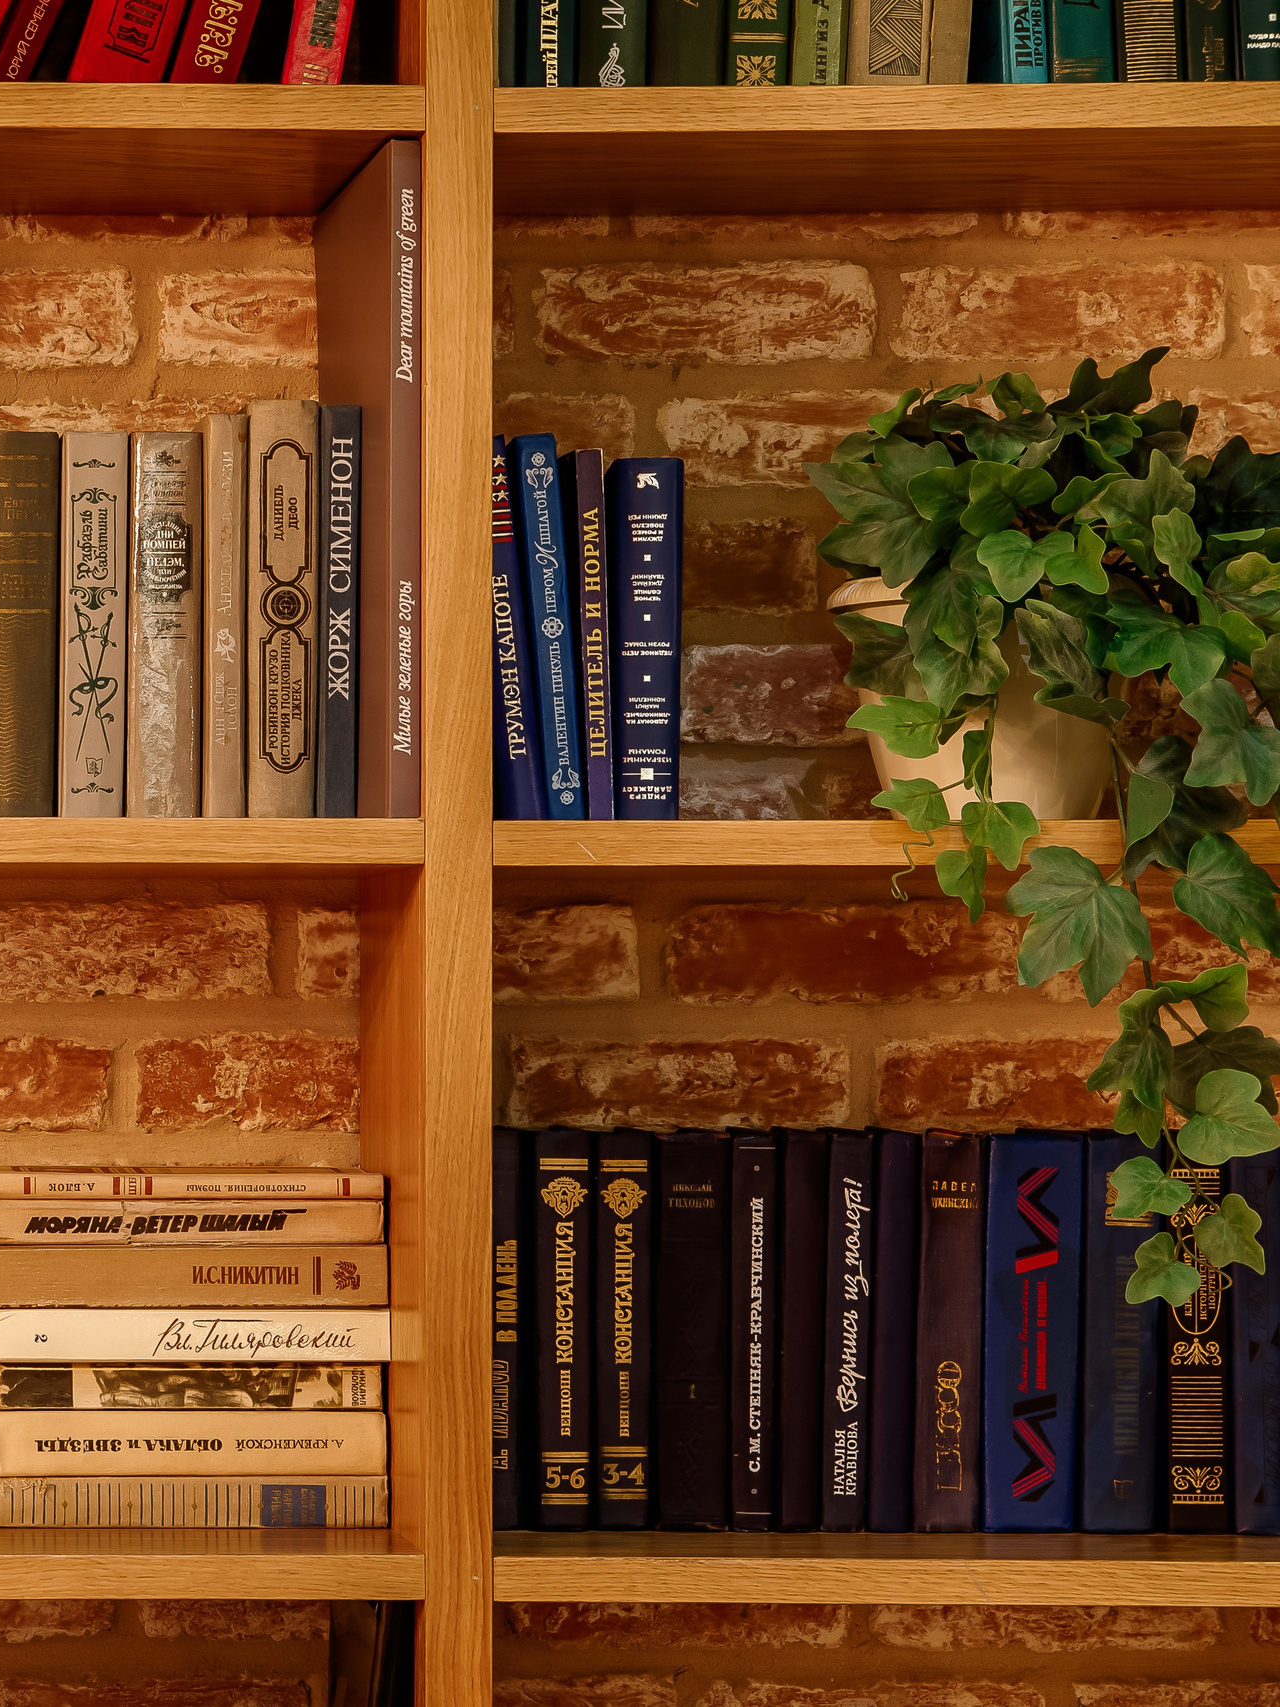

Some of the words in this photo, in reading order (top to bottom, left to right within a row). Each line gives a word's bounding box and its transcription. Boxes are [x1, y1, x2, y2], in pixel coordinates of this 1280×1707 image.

[539, 0, 559, 50] ПЛА
[1032, 9, 1043, 67] ПРОТИВ
[400, 187, 417, 232] green
[395, 230, 416, 251] of
[396, 254, 413, 338] mountains
[394, 341, 413, 383] Dear
[272, 483, 285, 540] ДАНИЕЛЬ
[287, 497, 300, 530] ДЕФО
[323, 436, 358, 593] СИМЕНОН
[75, 509, 98, 580] Рафаэль
[91, 506, 109, 580] Сабатини
[582, 507, 601, 592] НОРМА
[398, 578, 416, 620] горы
[490, 572, 517, 662] КАПОТЕ
[542, 566, 557, 612] ПЕРОМ
[585, 602, 602, 618] И
[267, 648, 279, 684] КРУЗО
[279, 630, 292, 709] ПОЛКОВНИКА
[324, 605, 354, 700] ЖОРЖ
[397, 624, 412, 690] зеленые
[547, 640, 564, 692] ПИКУЛЬ
[267, 688, 279, 748] РОБИНЗОН
[290, 677, 302, 720] ДЖЕКА
[500, 665, 527, 760] ТРУМЭН
[585, 627, 608, 756] ЦЕЛИТЕЛЬ
[280, 712, 291, 764] ИСТОРИЯ
[392, 694, 412, 755] Милые
[552, 693, 571, 766] ВАЛЕНТИН
[186, 1182, 220, 1192] ПОЭМЫ
[24, 1215, 122, 1236] МОРЯНА
[130, 1215, 198, 1236] ВЕТЕР
[198, 1208, 307, 1232] ШАЛЫЙ
[495, 1238, 517, 1323] ПОЛДЕНЬ
[554, 1220, 576, 1363] КОНСТАНЦИЯ
[613, 1221, 635, 1364] КОНСТАНЦИЯ
[841, 1257, 871, 1301] из
[495, 1328, 517, 1342] В
[746, 1196, 766, 1430] СТЕПНЯК-КРАВЧИНСКИЙ
[834, 1308, 869, 1412] Вернись
[559, 1368, 572, 1436] БЕНЦОНИ
[618, 1369, 631, 1437] БЕНЦОНИ
[34, 1436, 121, 1452] ЗВЕЗДЫ
[127, 1439, 141, 1449] и
[144, 1438, 222, 1452] ОБЛАКА
[236, 1438, 327, 1451] КРЕМЕНСКОЙ
[748, 1431, 762, 1453] М.
[748, 1455, 761, 1472] С.
[832, 1428, 848, 1495] НАТАЛЬЯ
[844, 1420, 860, 1496] КРАВЦОВА
[545, 1466, 586, 1490] 5-6
[603, 1462, 646, 1487] 3-4
